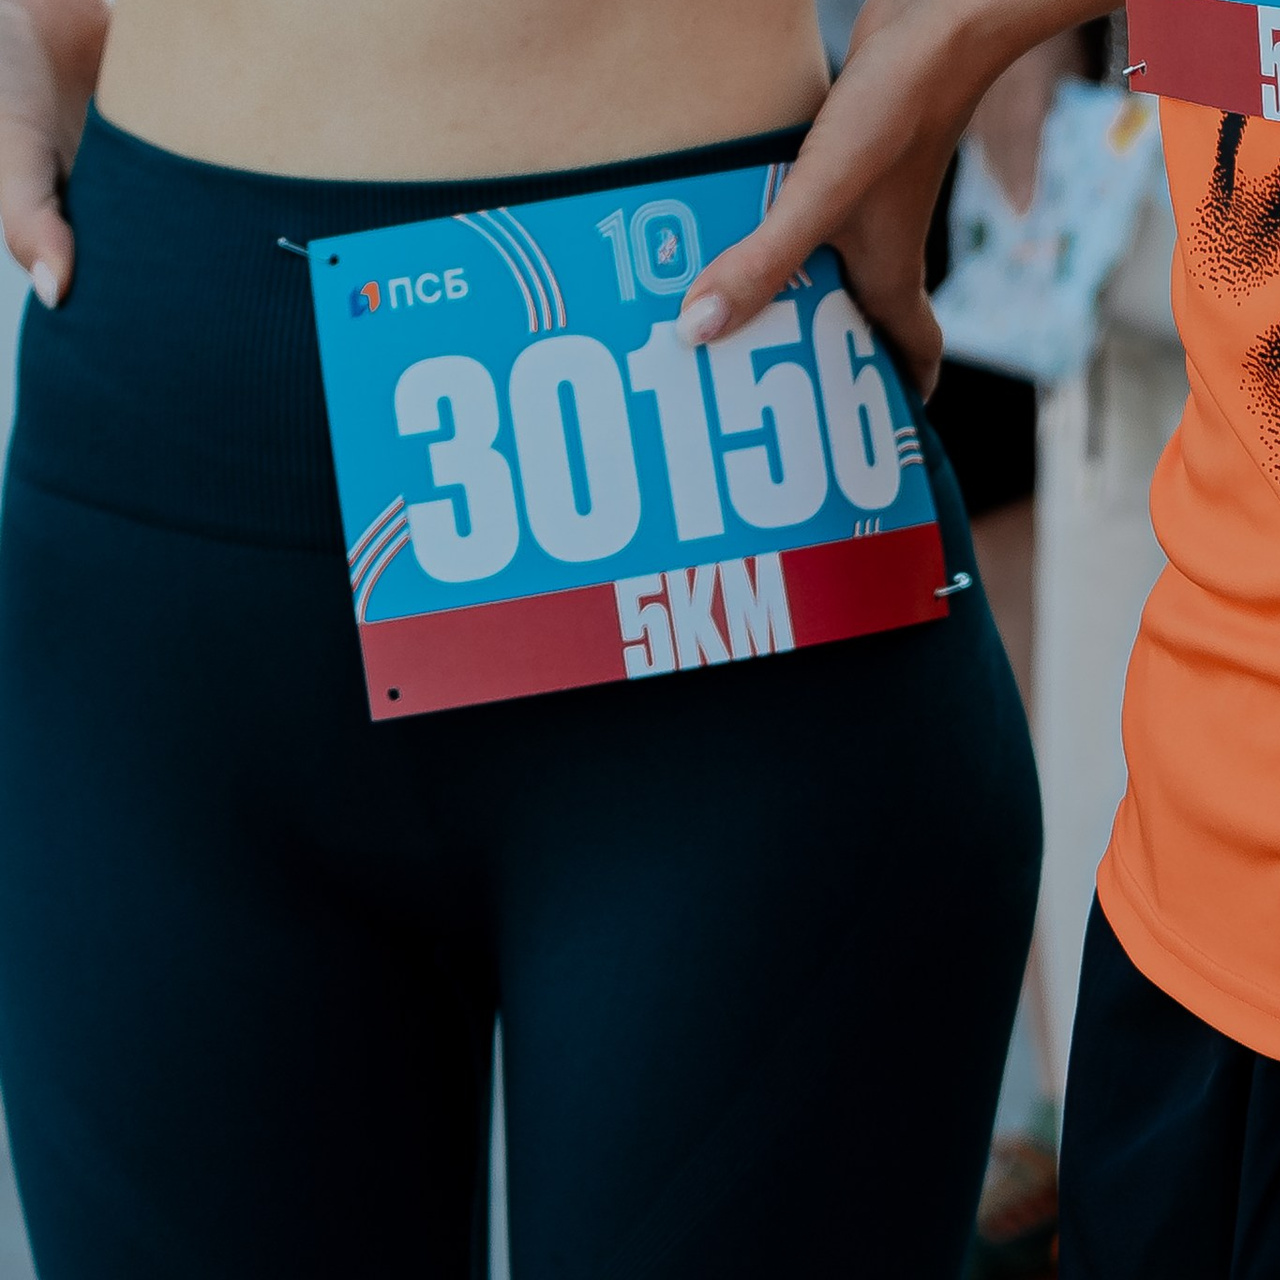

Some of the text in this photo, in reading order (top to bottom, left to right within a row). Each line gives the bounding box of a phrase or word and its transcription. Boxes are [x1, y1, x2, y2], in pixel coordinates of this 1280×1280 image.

[388, 268, 469, 309] ПСБ
[595, 199, 701, 302] 10
[394, 289, 901, 583] 30156
